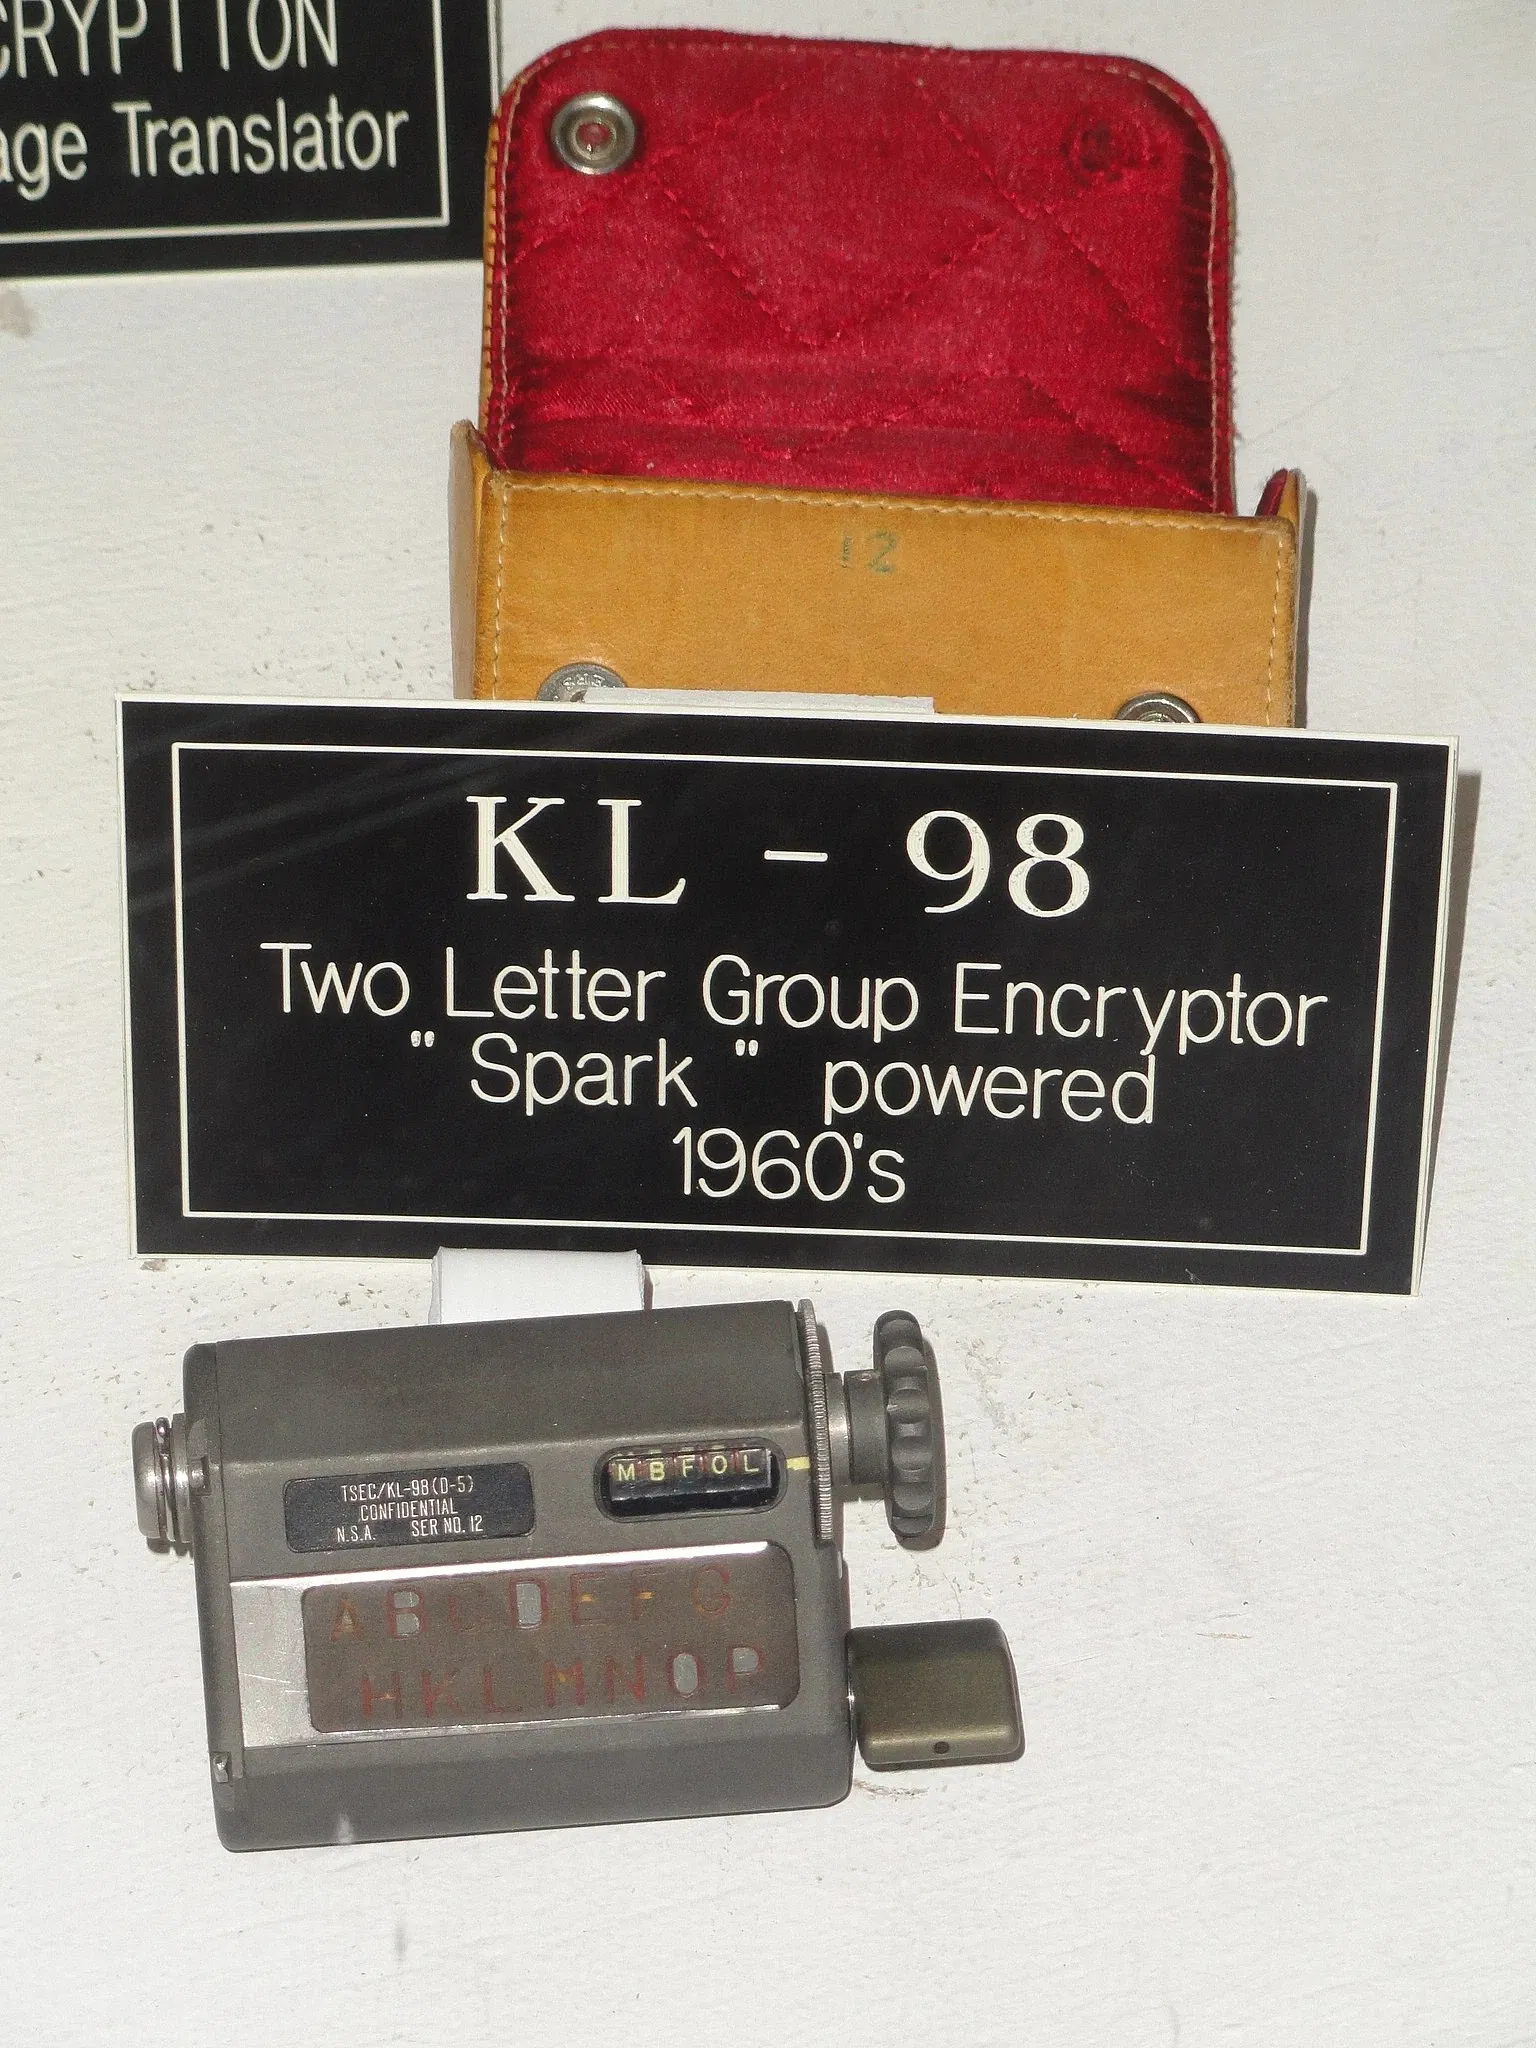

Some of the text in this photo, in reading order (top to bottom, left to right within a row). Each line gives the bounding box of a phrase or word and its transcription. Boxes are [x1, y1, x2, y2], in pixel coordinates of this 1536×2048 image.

[113, 95, 409, 178] Translator
[466, 796, 687, 905] KL
[906, 810, 1090, 918] 98
[260, 942, 1329, 1058] Two Letter Group Encryptor
[823, 1055, 1156, 1126] powered
[672, 1126, 906, 1204] 1960's
[341, 1474, 474, 1503] TSEC/KL-98(D-5)
[360, 1498, 458, 1522] CONFIDENTIAL
[336, 1514, 484, 1543] N.S.A. SER NO. 12
